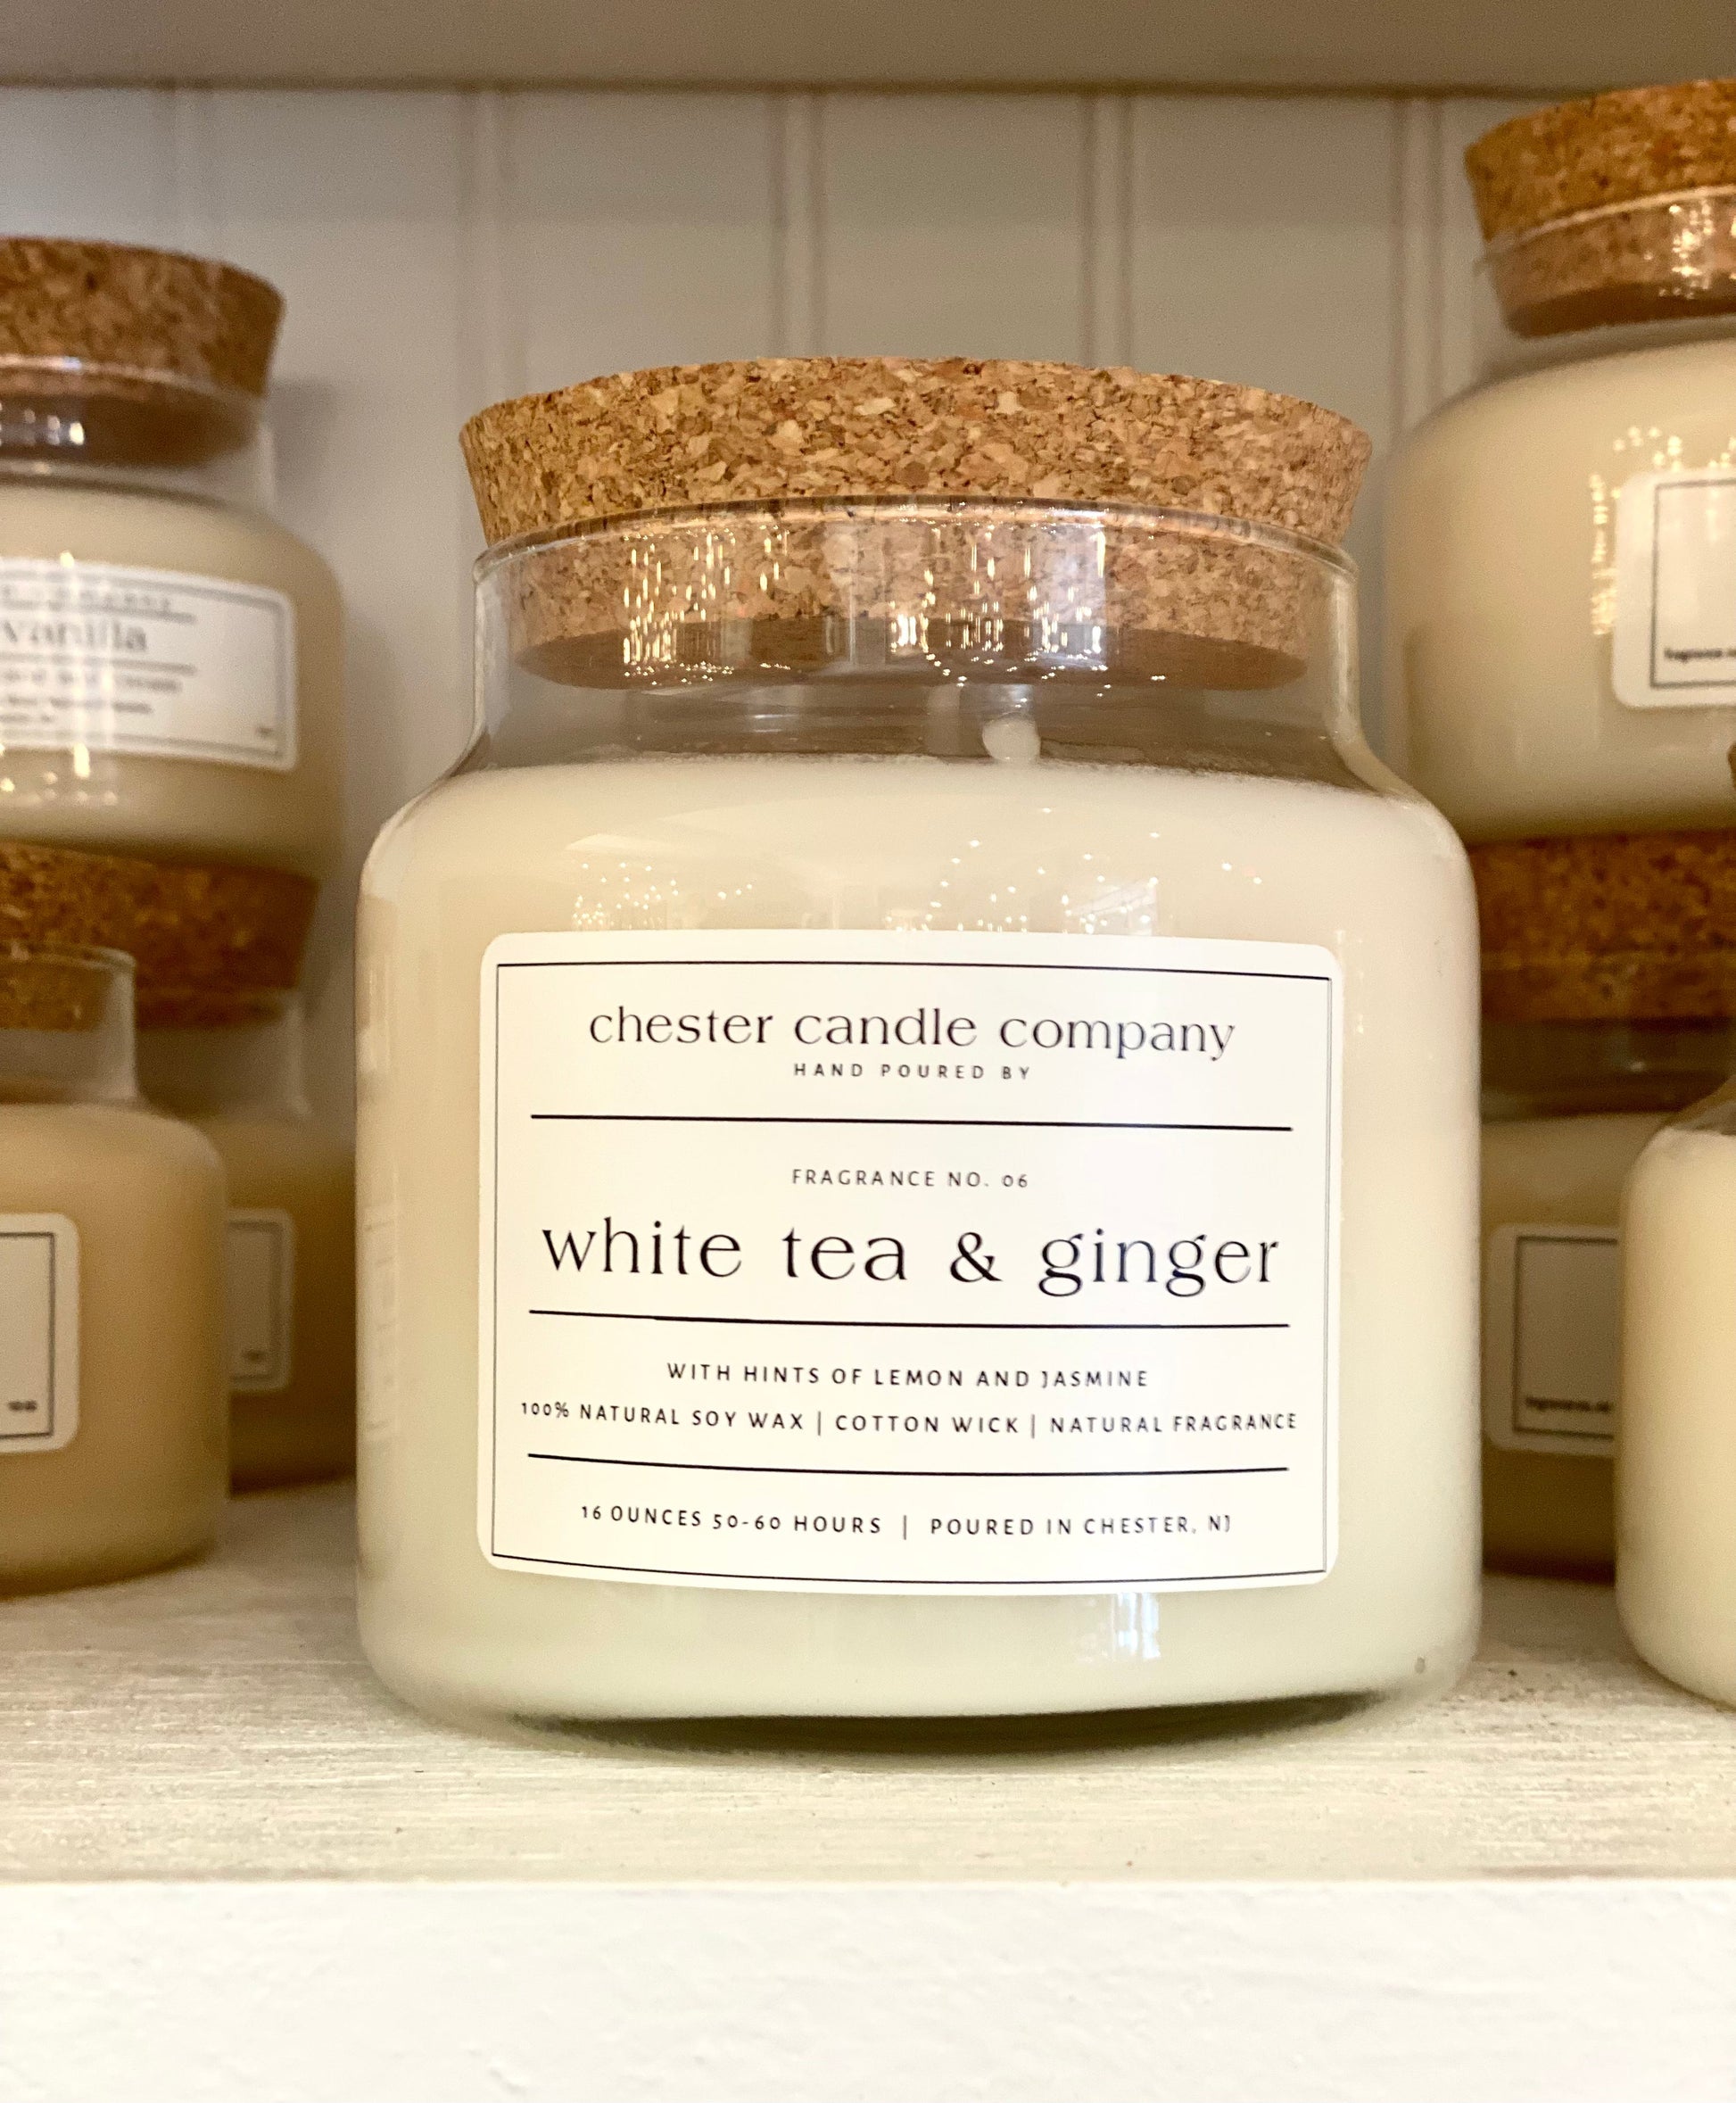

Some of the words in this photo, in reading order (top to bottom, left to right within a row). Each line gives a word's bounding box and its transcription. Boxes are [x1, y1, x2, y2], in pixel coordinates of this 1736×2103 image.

[589, 1005, 774, 1045] chester
[793, 1007, 977, 1047] candle
[998, 1018, 1236, 1062] company
[794, 1063, 864, 1078] HAND
[880, 1064, 984, 1080] POURED
[1002, 1065, 1029, 1080] BY
[792, 1168, 935, 1188] FRAGRANCE
[947, 1171, 989, 1188] NO.
[1002, 1173, 1028, 1188] 06
[541, 1215, 742, 1279] white
[781, 1227, 907, 1282] tea
[949, 1231, 1004, 1284] &
[1037, 1227, 1279, 1298] ginger
[666, 1362, 731, 1382] WITH
[743, 1365, 820, 1385] HINTS
[831, 1368, 863, 1386] OF
[874, 1369, 963, 1387] LEMON
[976, 1370, 1029, 1387] AND
[1041, 1370, 1147, 1389] JASMINE
[521, 1401, 570, 1419] 100%
[579, 1403, 681, 1426] NATURAL
[691, 1409, 737, 1428] SOY
[748, 1412, 804, 1430] WAX
[835, 1414, 938, 1433] COTTON
[951, 1416, 1019, 1434] WICK
[1050, 1416, 1162, 1434] NATURAL
[1173, 1412, 1296, 1432] FRAGRANCE
[581, 1505, 602, 1520] 16
[610, 1505, 701, 1528] OUNCES
[712, 1513, 781, 1531] 50-60
[793, 1514, 880, 1535] HOURS
[930, 1518, 1034, 1536] POURED
[1046, 1519, 1071, 1536] IN
[1083, 1516, 1196, 1535] CHESTER,
[1208, 1514, 1230, 1533] NJ
